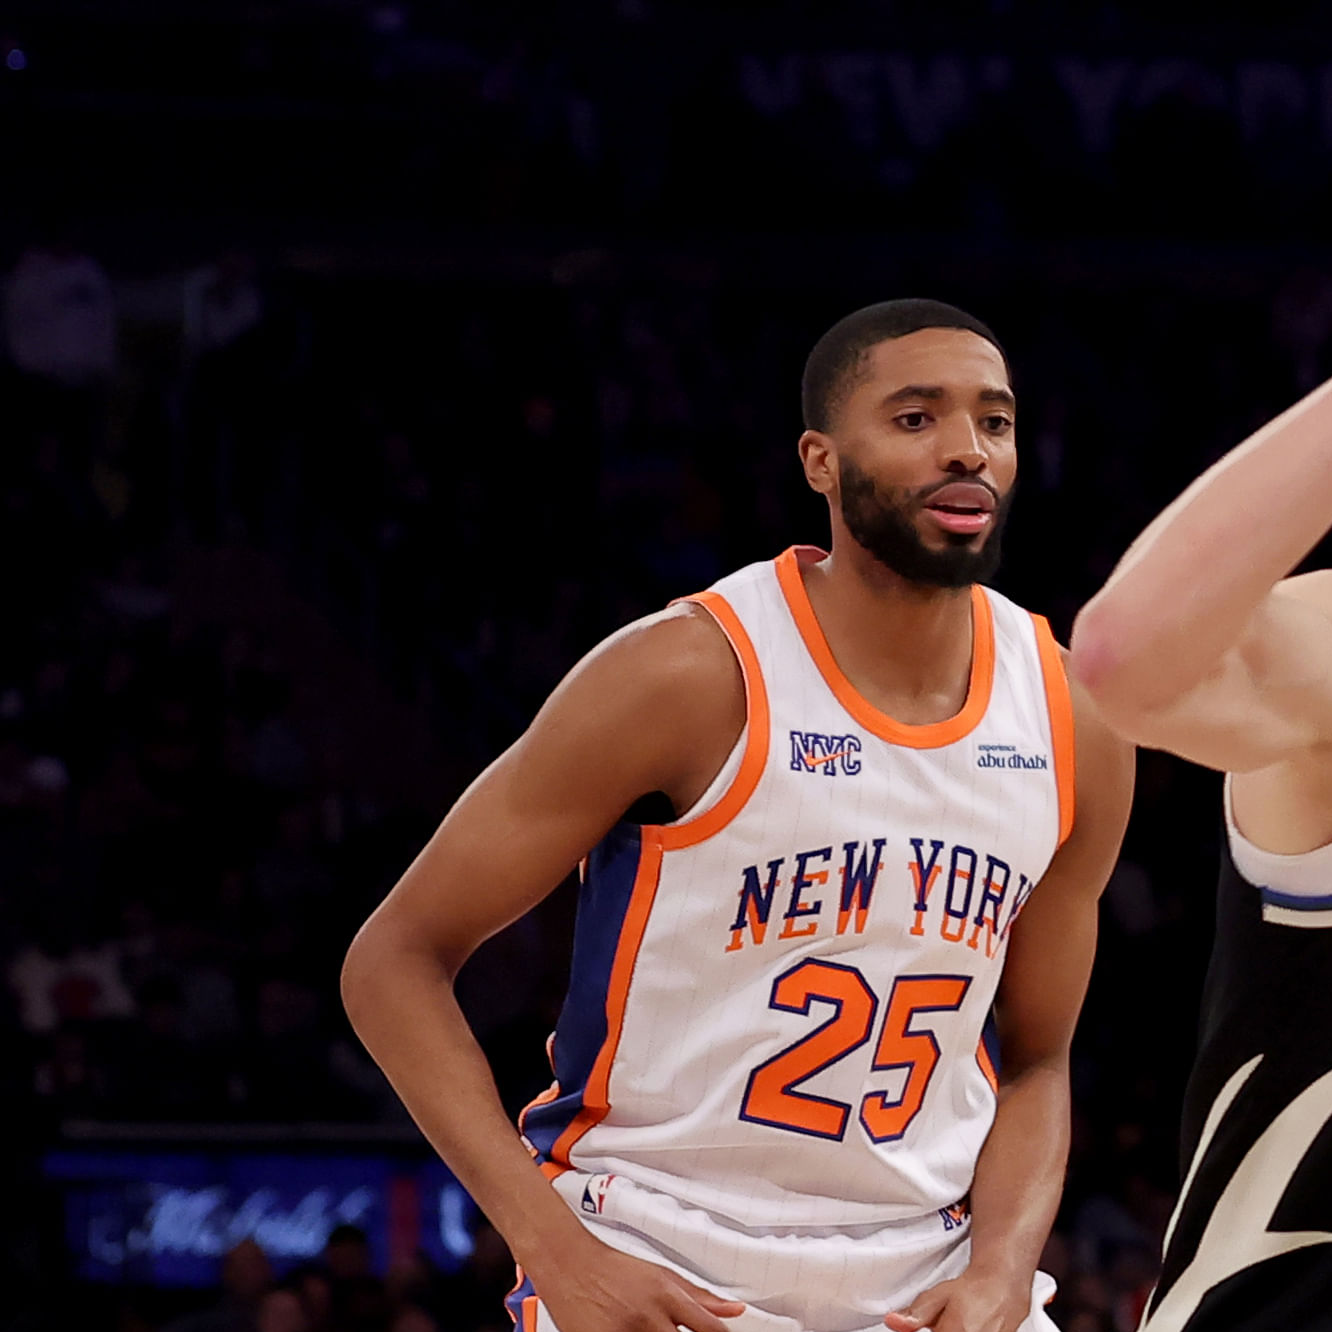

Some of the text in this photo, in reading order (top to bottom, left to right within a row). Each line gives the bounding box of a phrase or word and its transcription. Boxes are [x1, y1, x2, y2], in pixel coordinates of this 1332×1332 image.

[790, 731, 861, 776] NYC
[977, 753, 1048, 770] abu dhabi
[725, 838, 887, 952] NEW
[738, 956, 974, 1144] 25
